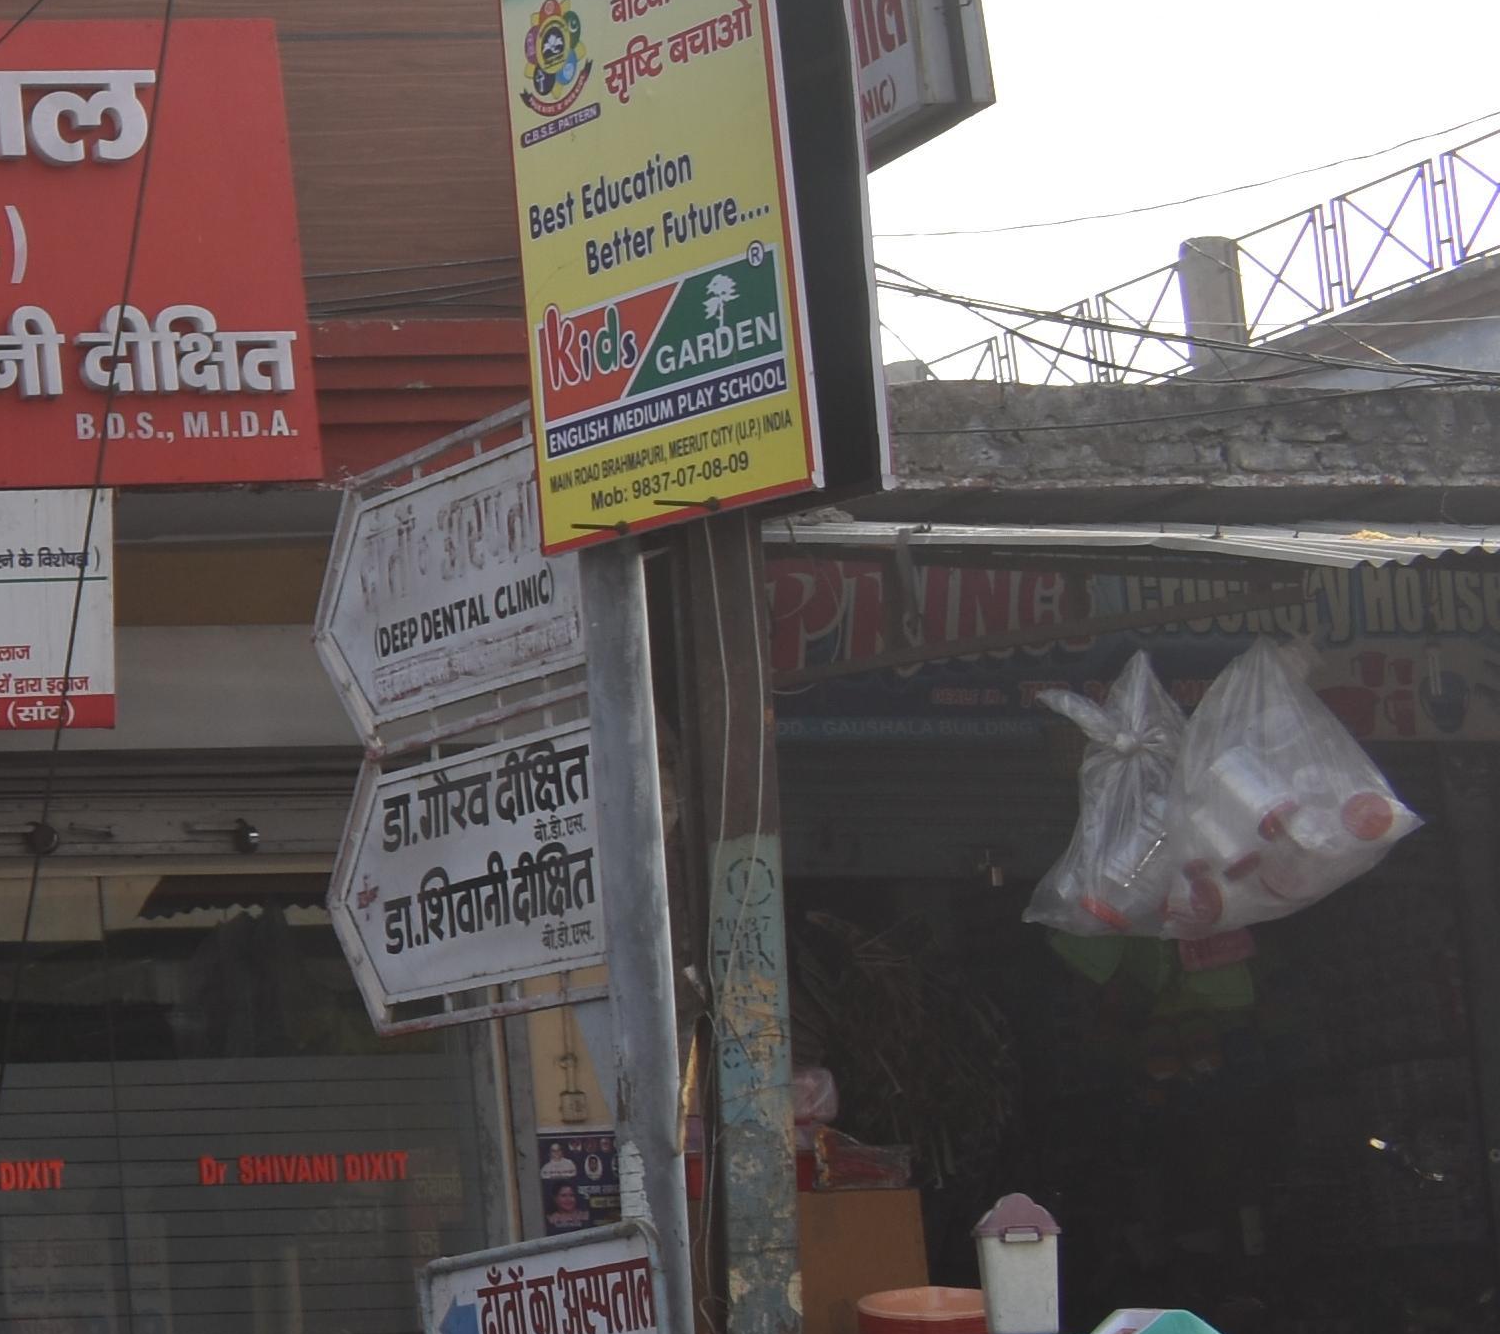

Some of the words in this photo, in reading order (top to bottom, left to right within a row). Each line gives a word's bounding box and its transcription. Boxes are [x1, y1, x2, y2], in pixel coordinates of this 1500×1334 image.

[603, 34, 663, 104] सृष्टि
[558, 104, 599, 132] PATTERN
[528, 188, 579, 241] Best
[581, 152, 692, 219] Education
[585, 223, 656, 276] Better
[75, 302, 297, 396] दीक्षित
[543, 302, 639, 392] Kids
[655, 311, 779, 376] GARDEN
[75, 411, 175, 444] B.D.S.,
[182, 409, 298, 439] M.I.D.A.
[549, 418, 610, 454] ENGLISH
[612, 398, 674, 435] MEDIUM
[677, 386, 716, 416] PLAY
[718, 366, 786, 403] SCHOOL
[549, 472, 573, 494] MAIN
[601, 447, 667, 480] BRAHMAPURI,
[668, 436, 709, 459] MEERUT
[591, 485, 629, 511] Mob:
[631, 450, 750, 499] 9837-07-08-09
[374, 618, 419, 661] (DEEP
[421, 593, 491, 645] DENTAL
[493, 559, 555, 621] CLINIC)
[495, 739, 589, 826] दीक्षित
[511, 841, 596, 924] दीक्षित
[239, 1153, 338, 1185] SHIVANI
[344, 1151, 409, 1182] DIXIT
